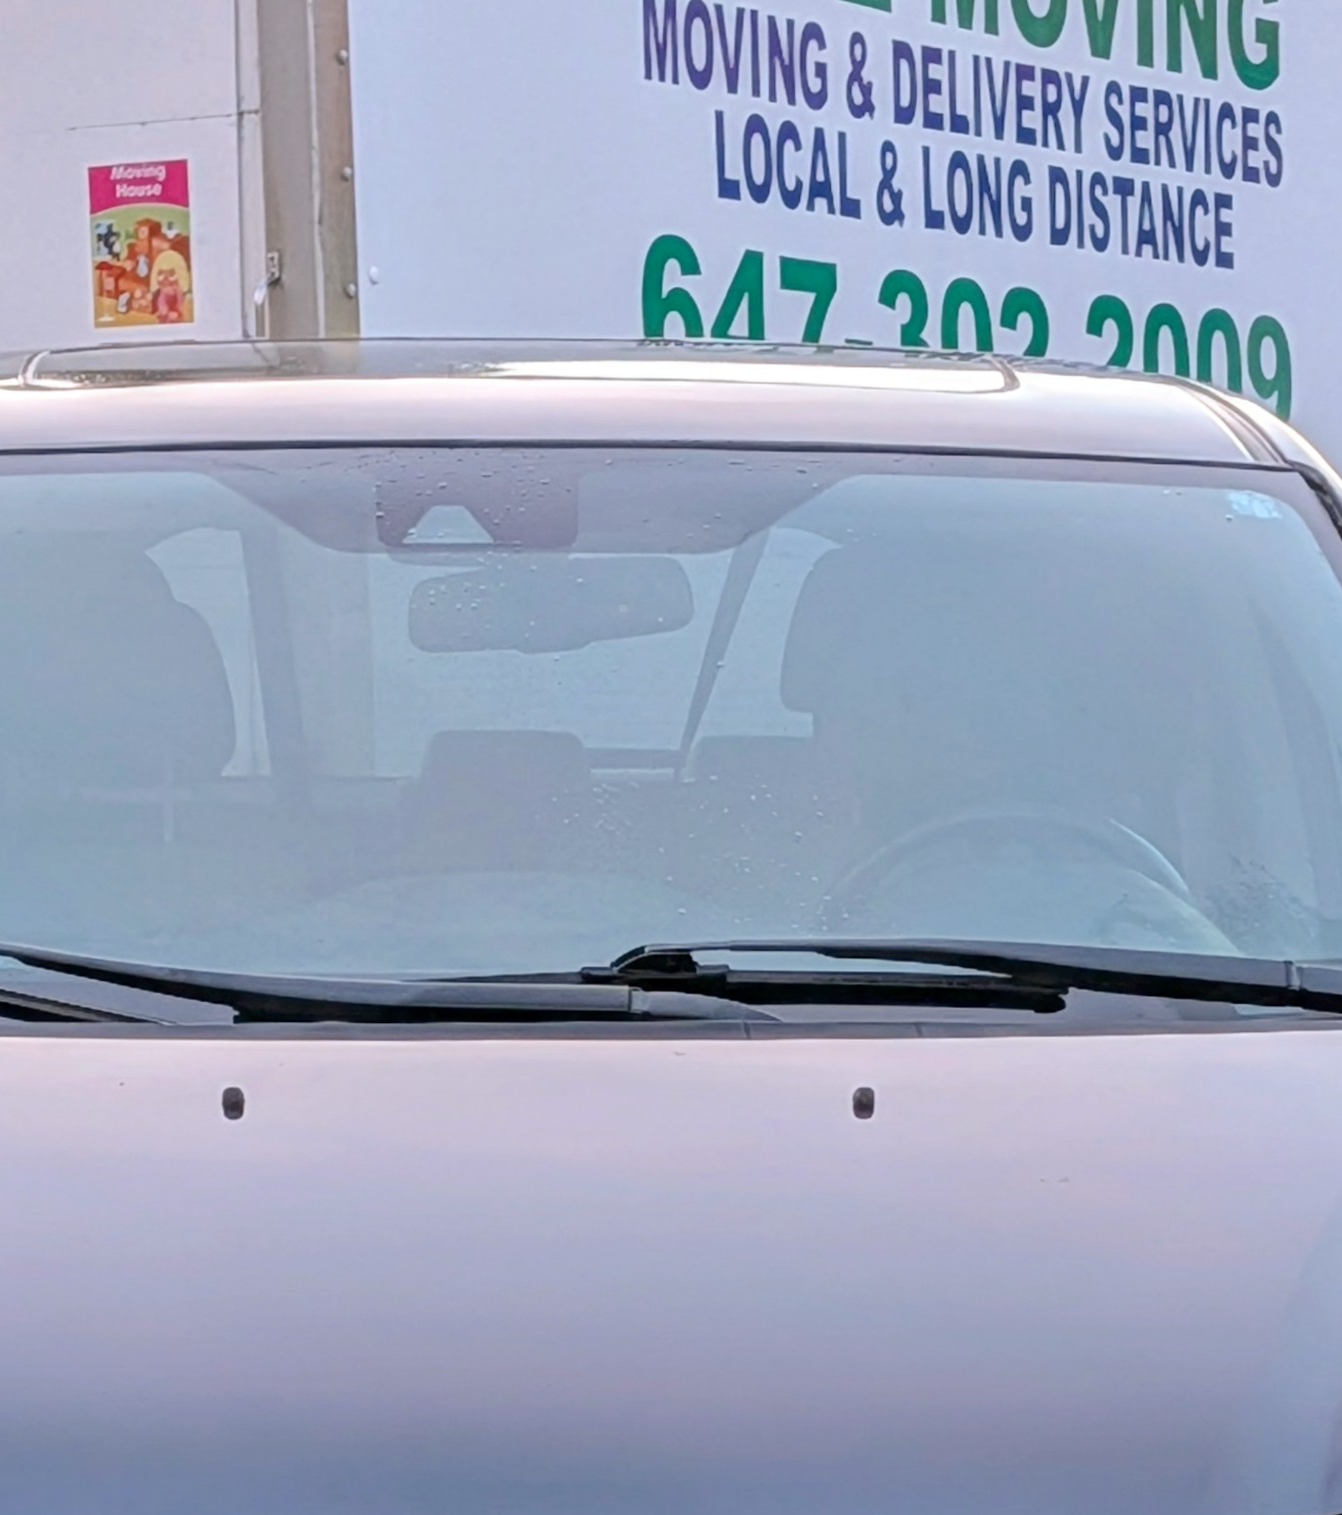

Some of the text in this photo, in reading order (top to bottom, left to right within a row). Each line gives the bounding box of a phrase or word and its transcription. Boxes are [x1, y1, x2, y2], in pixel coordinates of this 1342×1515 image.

[641, 0, 1284, 189] MOVING & DELIVERY SERVICES
[714, 109, 1236, 270] LOCAL & LONG DISTANCE
[641, 233, 1292, 424] 6473022009
